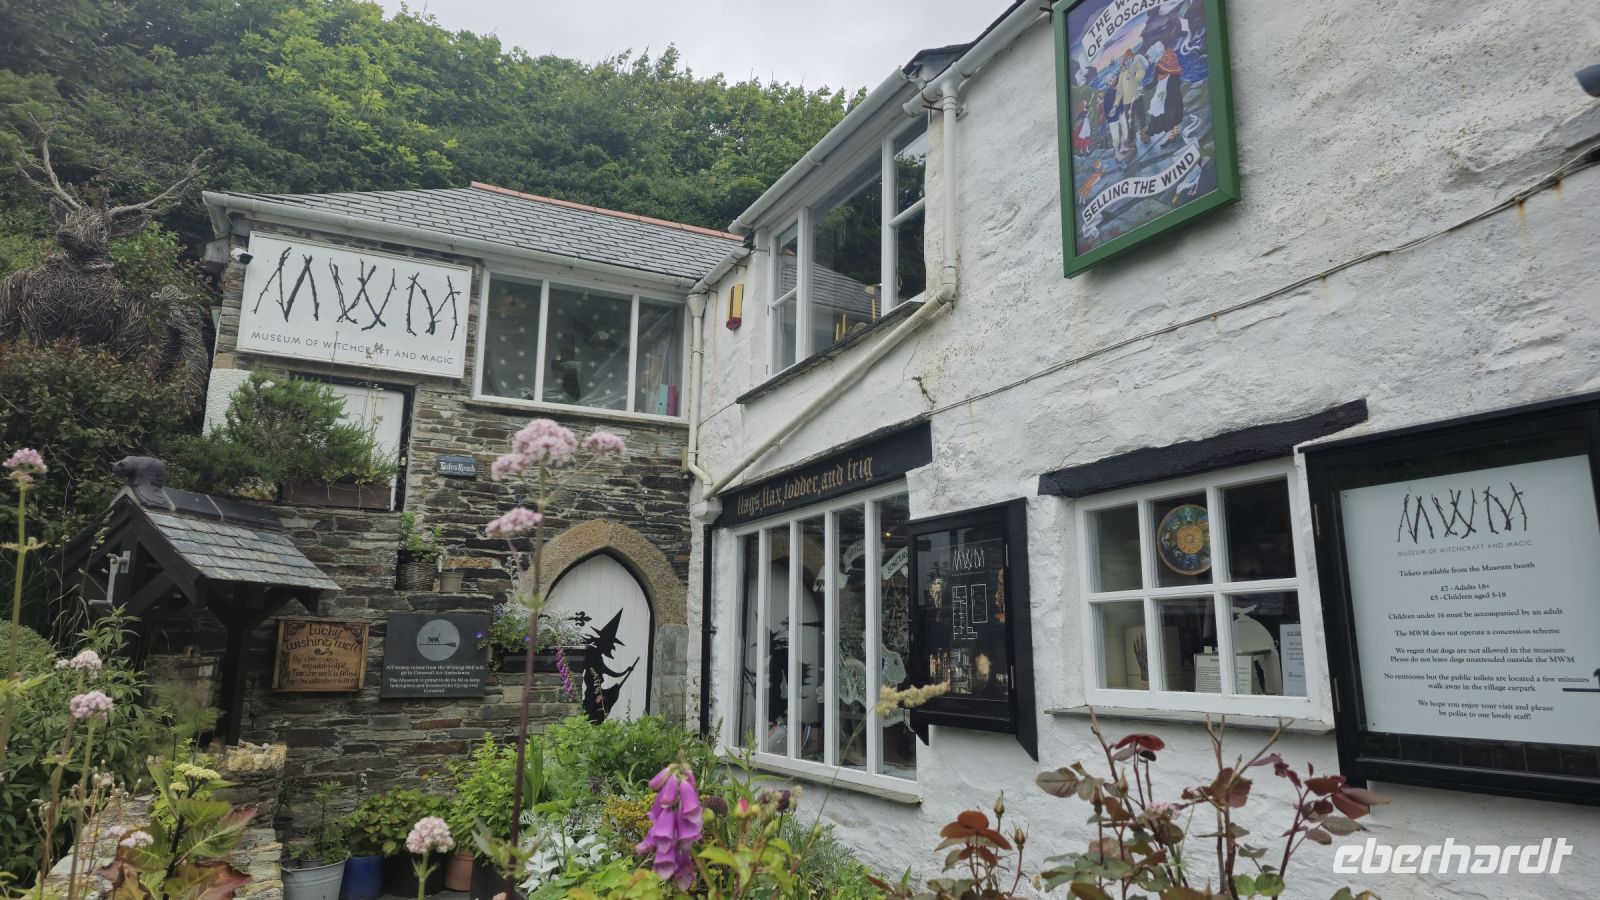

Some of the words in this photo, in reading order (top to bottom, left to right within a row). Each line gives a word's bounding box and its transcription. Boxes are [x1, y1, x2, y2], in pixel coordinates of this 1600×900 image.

[1088, 10, 1111, 38] THE
[1088, 35, 1102, 57] OF
[1084, 181, 1129, 222] SELLING
[1134, 179, 1156, 195] THE
[1161, 152, 1194, 186] WIND
[251, 246, 461, 341] MWM
[251, 332, 301, 344] MUSEUM
[394, 350, 417, 360] AND
[421, 354, 453, 365] MAGIC
[1398, 482, 1526, 544] MWM
[1397, 549, 1426, 557] MUSEUM
[1439, 545, 1484, 553] WITCHCRAFT
[1487, 542, 1504, 550] AND
[1507, 540, 1533, 548] MAGIC
[1451, 566, 1468, 574] from
[1443, 593, 1473, 601] Children
[1474, 592, 1490, 600] aged
[1491, 591, 1507, 599] 5-18
[1388, 612, 1416, 620] Children
[1473, 609, 1520, 618] accompanied
[1521, 608, 1530, 616] by
[309, 623, 342, 639] Lucky
[1440, 647, 1456, 655] dogs
[1484, 684, 1506, 692] village
[1430, 700, 1445, 708] hope
[1531, 704, 1554, 712] please
[1491, 712, 1512, 720] lovely
